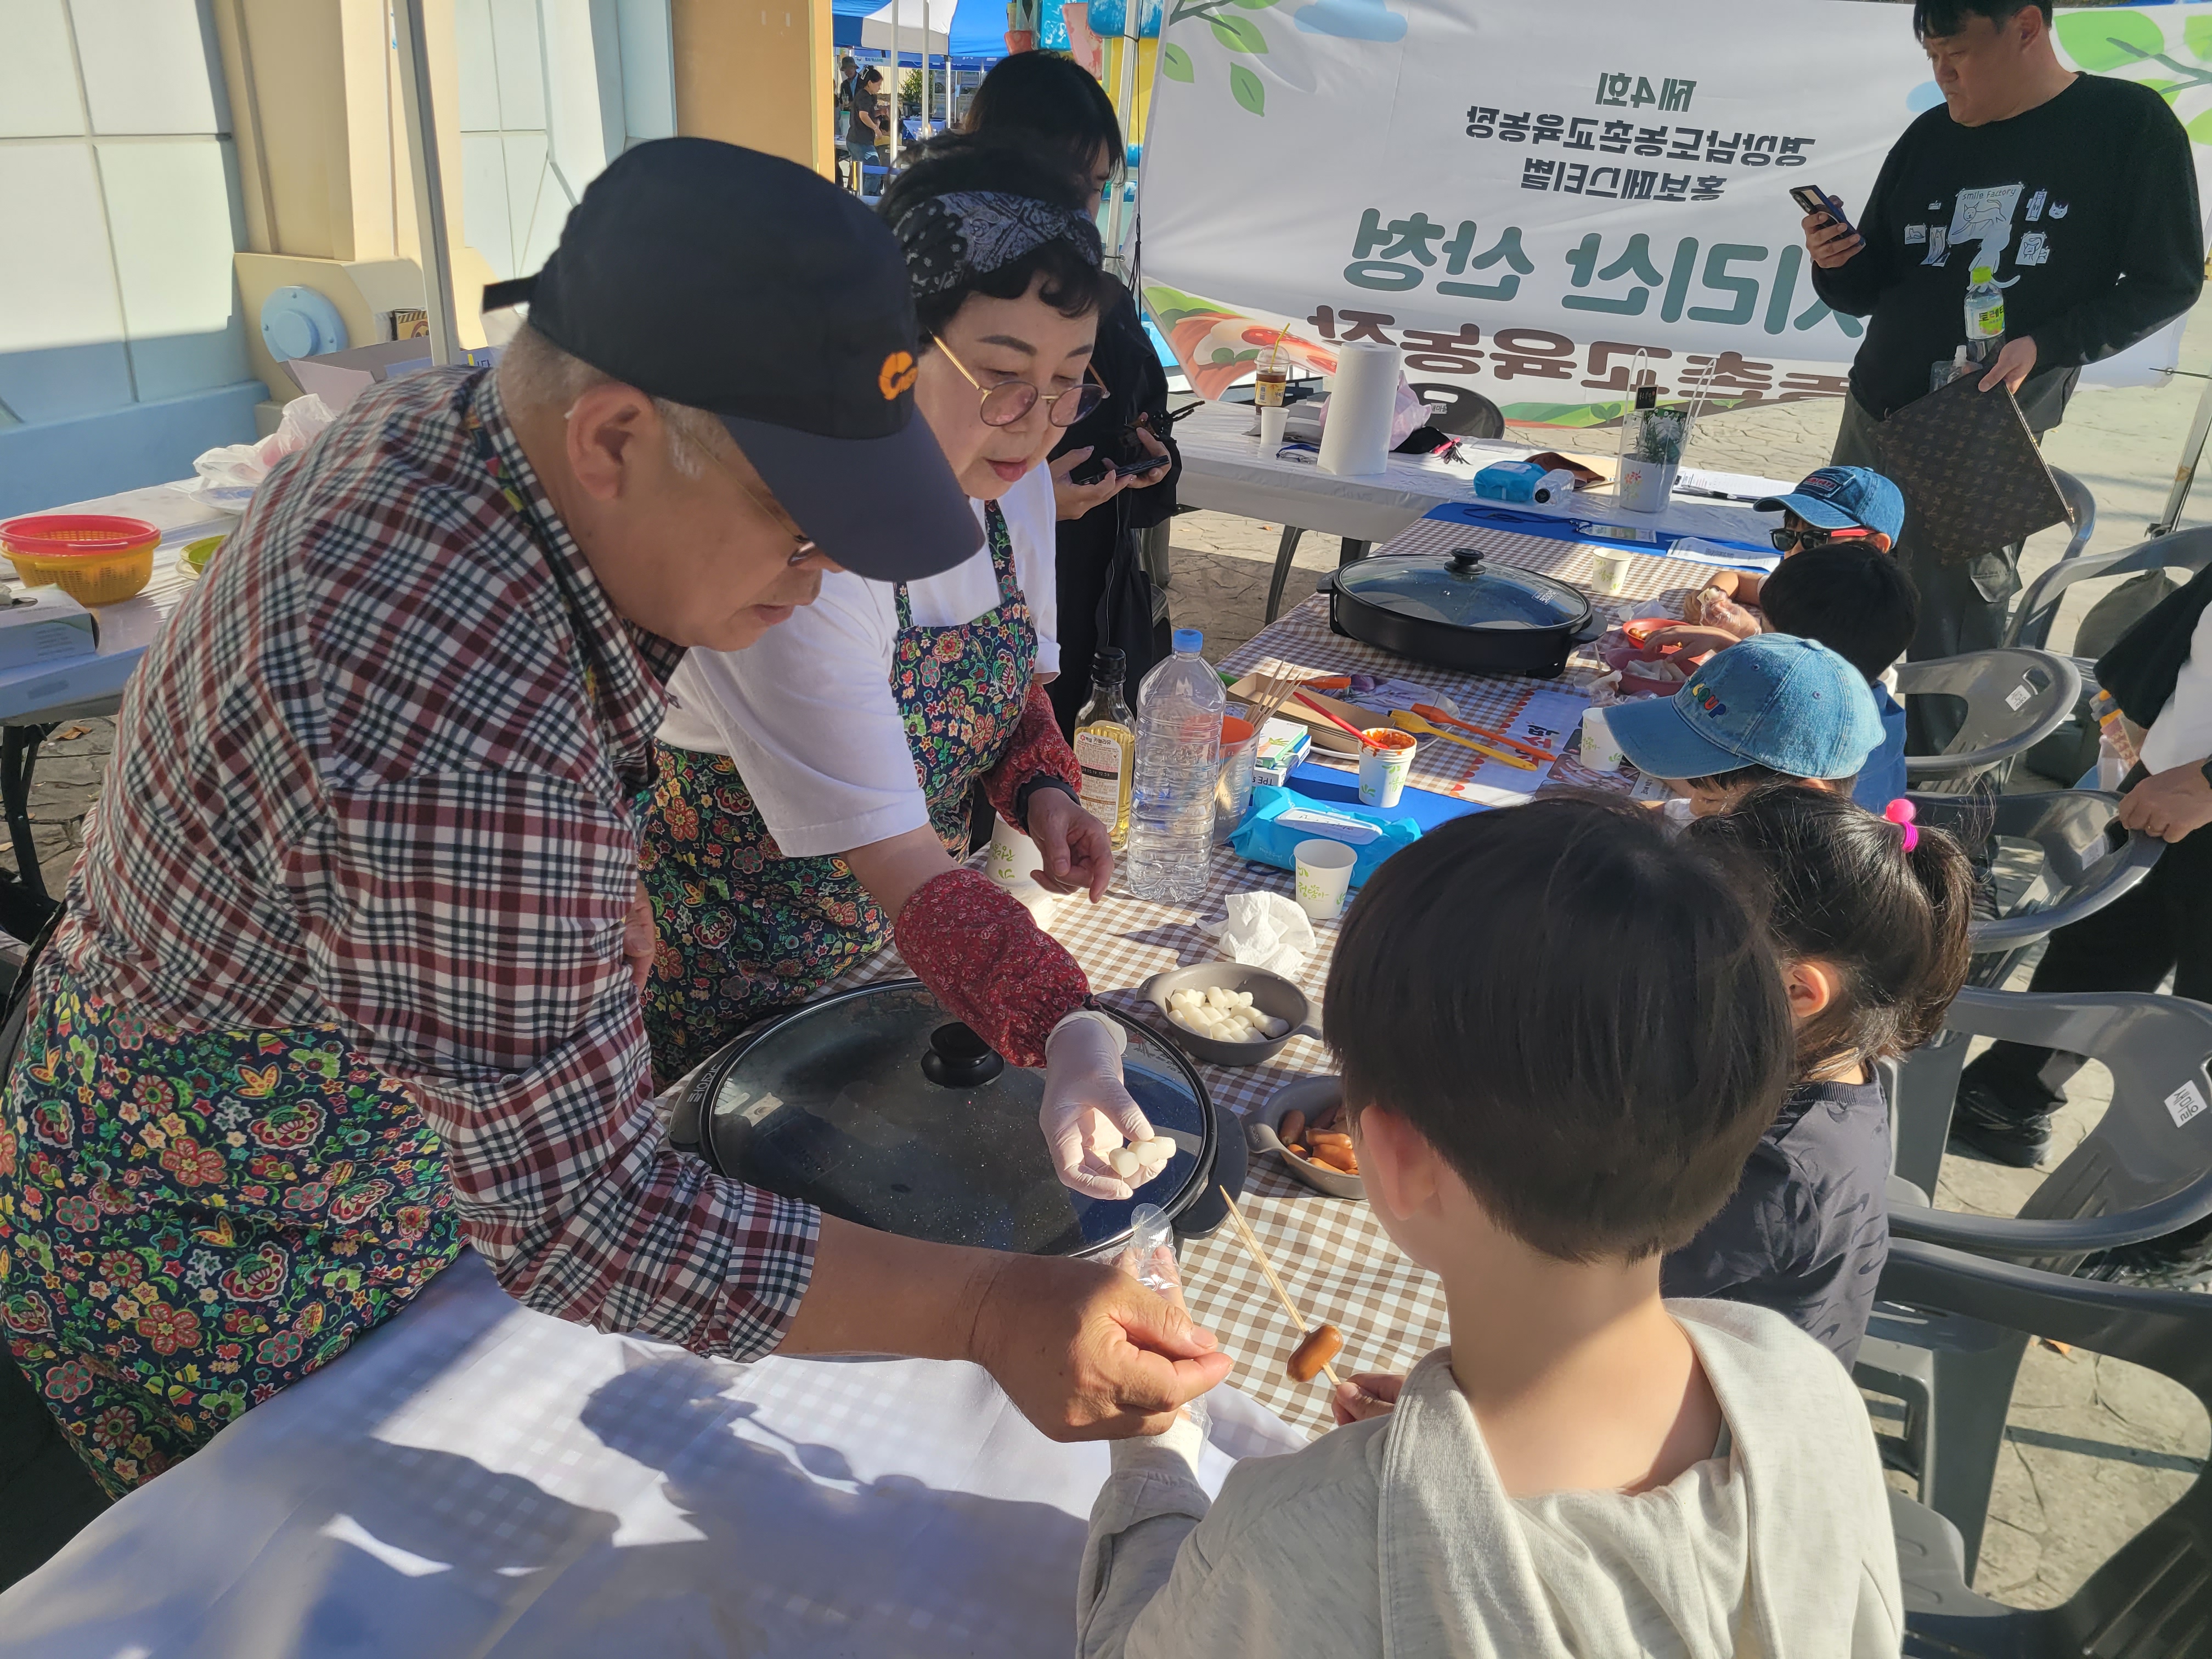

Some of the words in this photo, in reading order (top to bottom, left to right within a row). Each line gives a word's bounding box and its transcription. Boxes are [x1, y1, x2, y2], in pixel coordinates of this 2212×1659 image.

[1962, 191, 1984, 200] smile
[1691, 679, 1726, 719] COUP
[2173, 1088, 2199, 1122] 새마을
